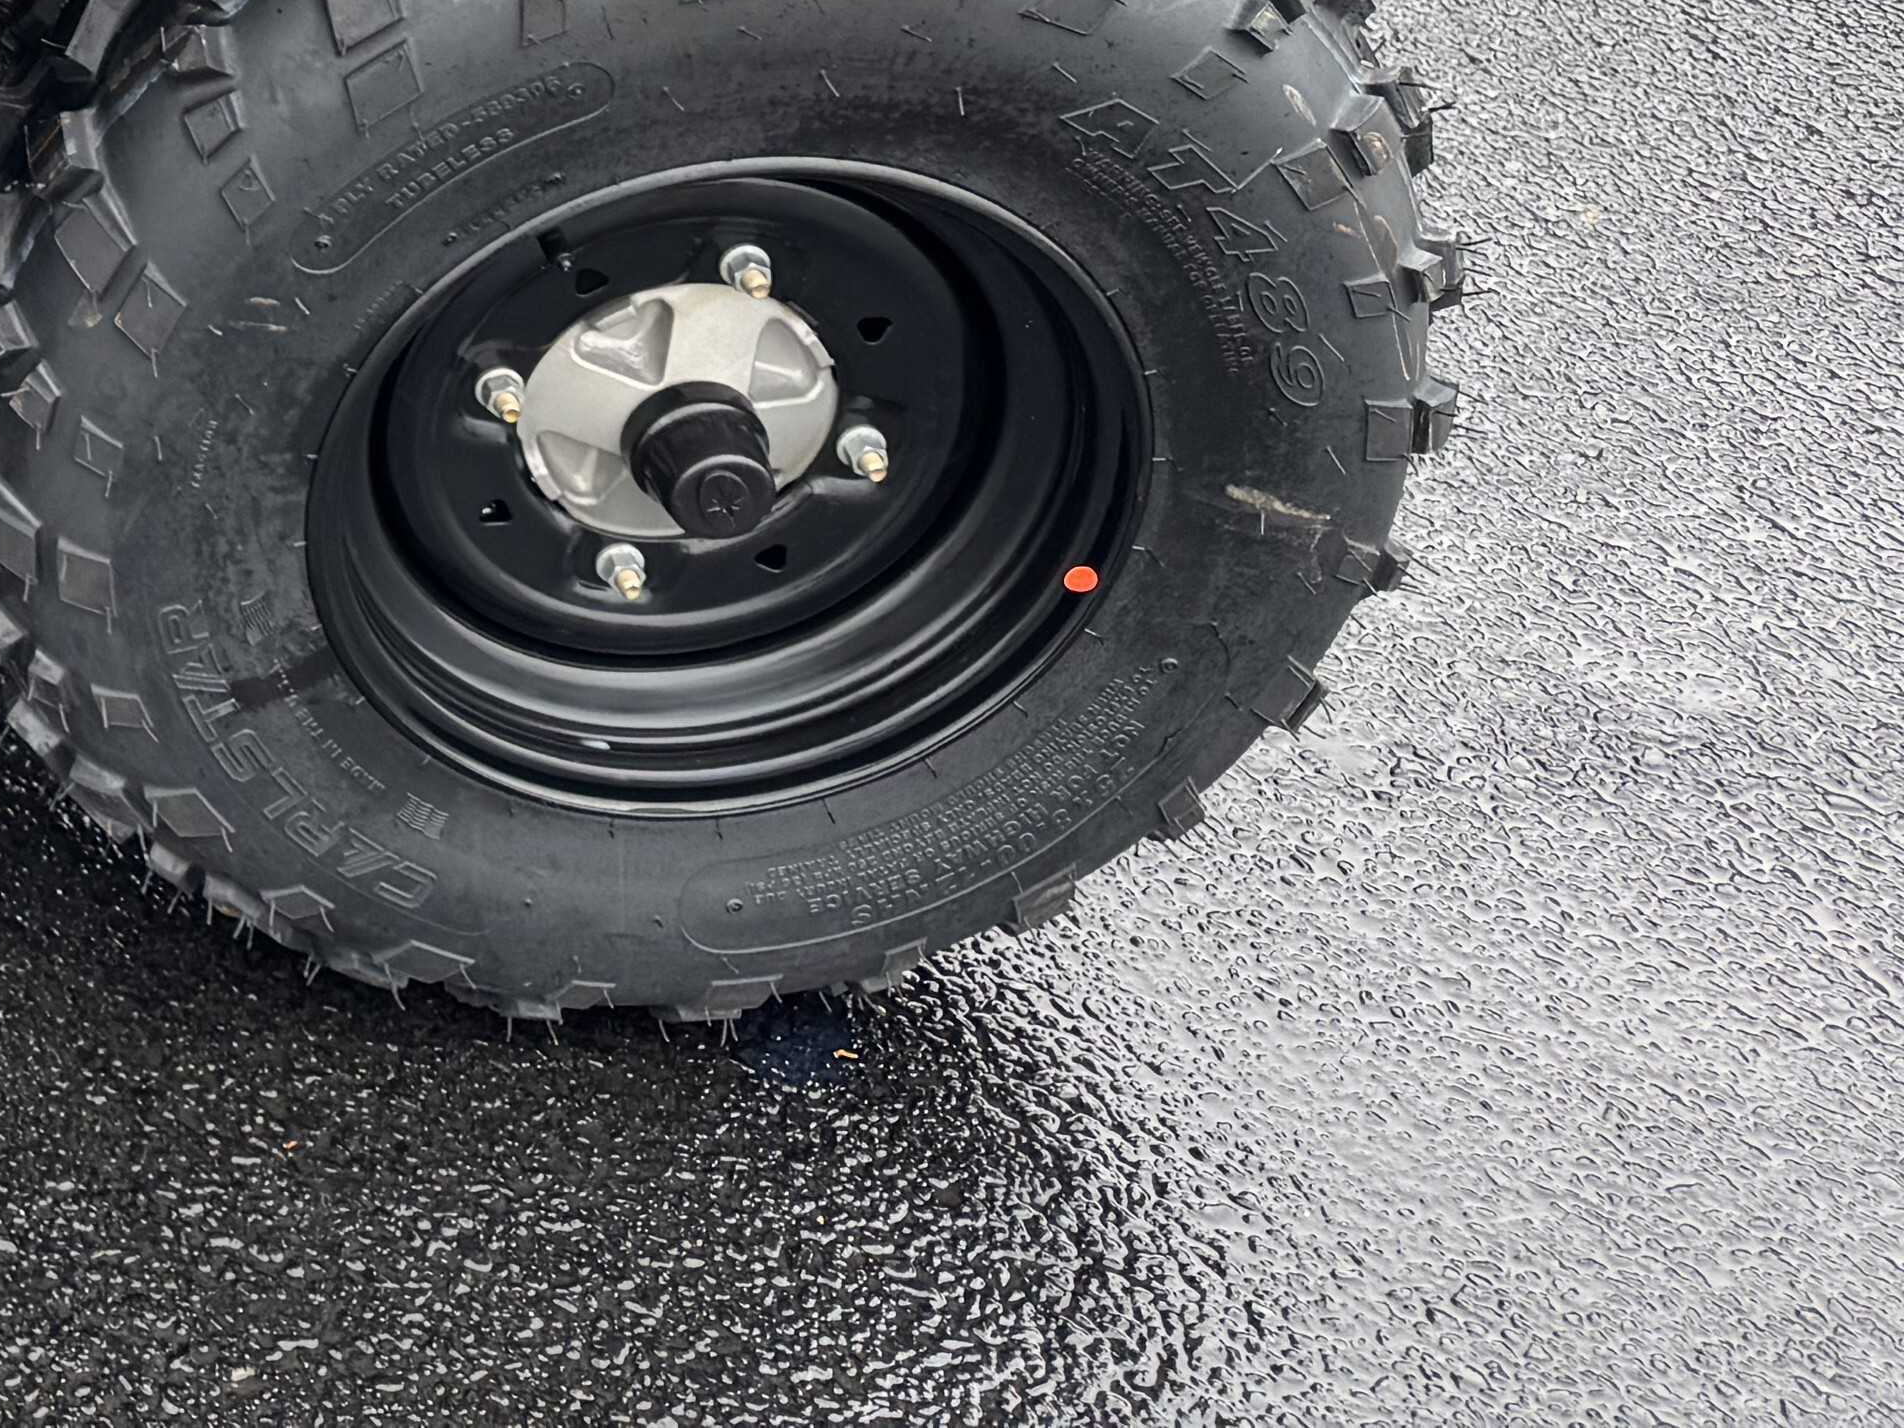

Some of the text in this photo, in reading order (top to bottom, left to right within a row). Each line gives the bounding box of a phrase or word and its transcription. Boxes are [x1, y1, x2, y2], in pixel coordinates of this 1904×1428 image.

[383, 125, 518, 214] TUBELESS
[1058, 97, 1328, 409] AT489
[158, 598, 441, 910] CARLSTAR
[1097, 716, 1146, 764] NOT
[1047, 759, 1101, 806] FOR
[931, 796, 1051, 875] HIGHWAY
[805, 861, 923, 917] SERVICE
